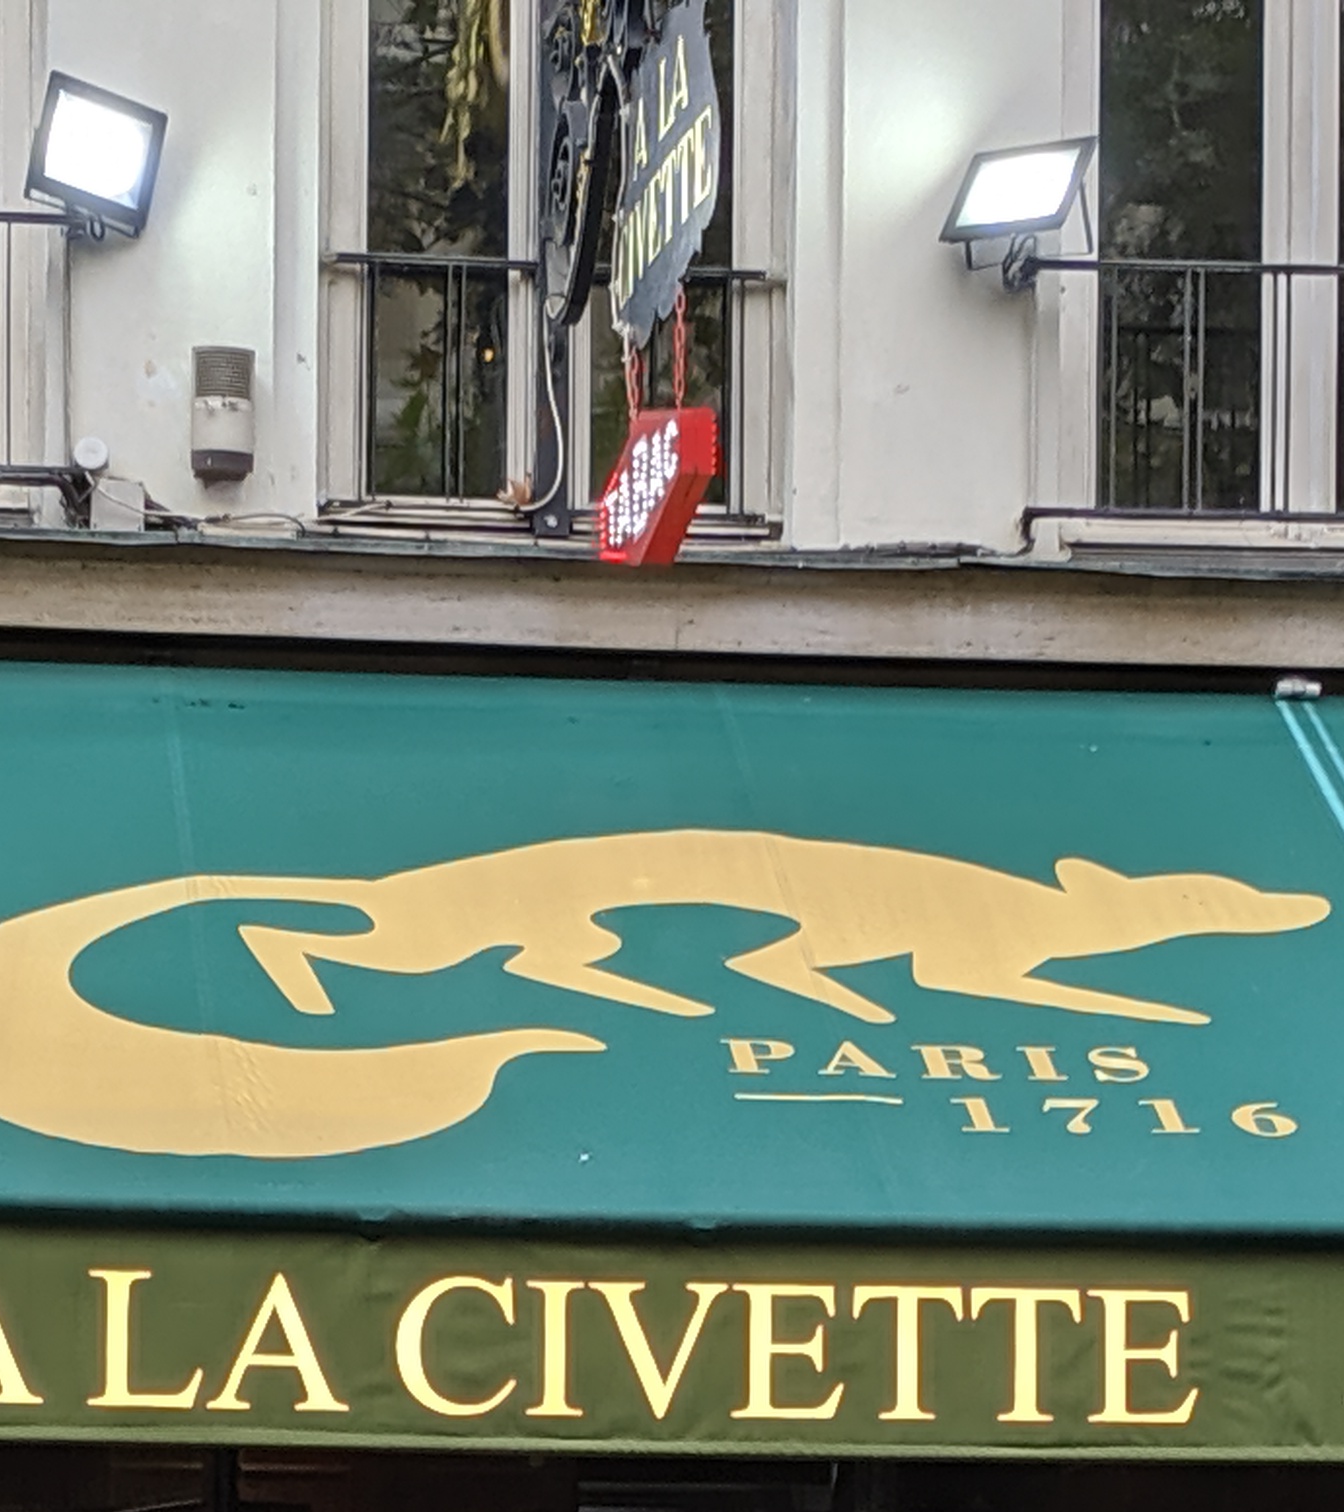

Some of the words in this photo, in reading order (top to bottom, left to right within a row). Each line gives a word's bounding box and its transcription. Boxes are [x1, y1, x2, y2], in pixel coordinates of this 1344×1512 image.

[632, 95, 648, 182] A
[657, 33, 690, 142] LA
[616, 104, 713, 310] CIVETTE
[719, 1037, 1151, 1083] PARIS
[950, 1097, 1299, 1138] 1716
[86, 1267, 349, 1412] LA
[393, 1275, 1199, 1425] CIVETTE
